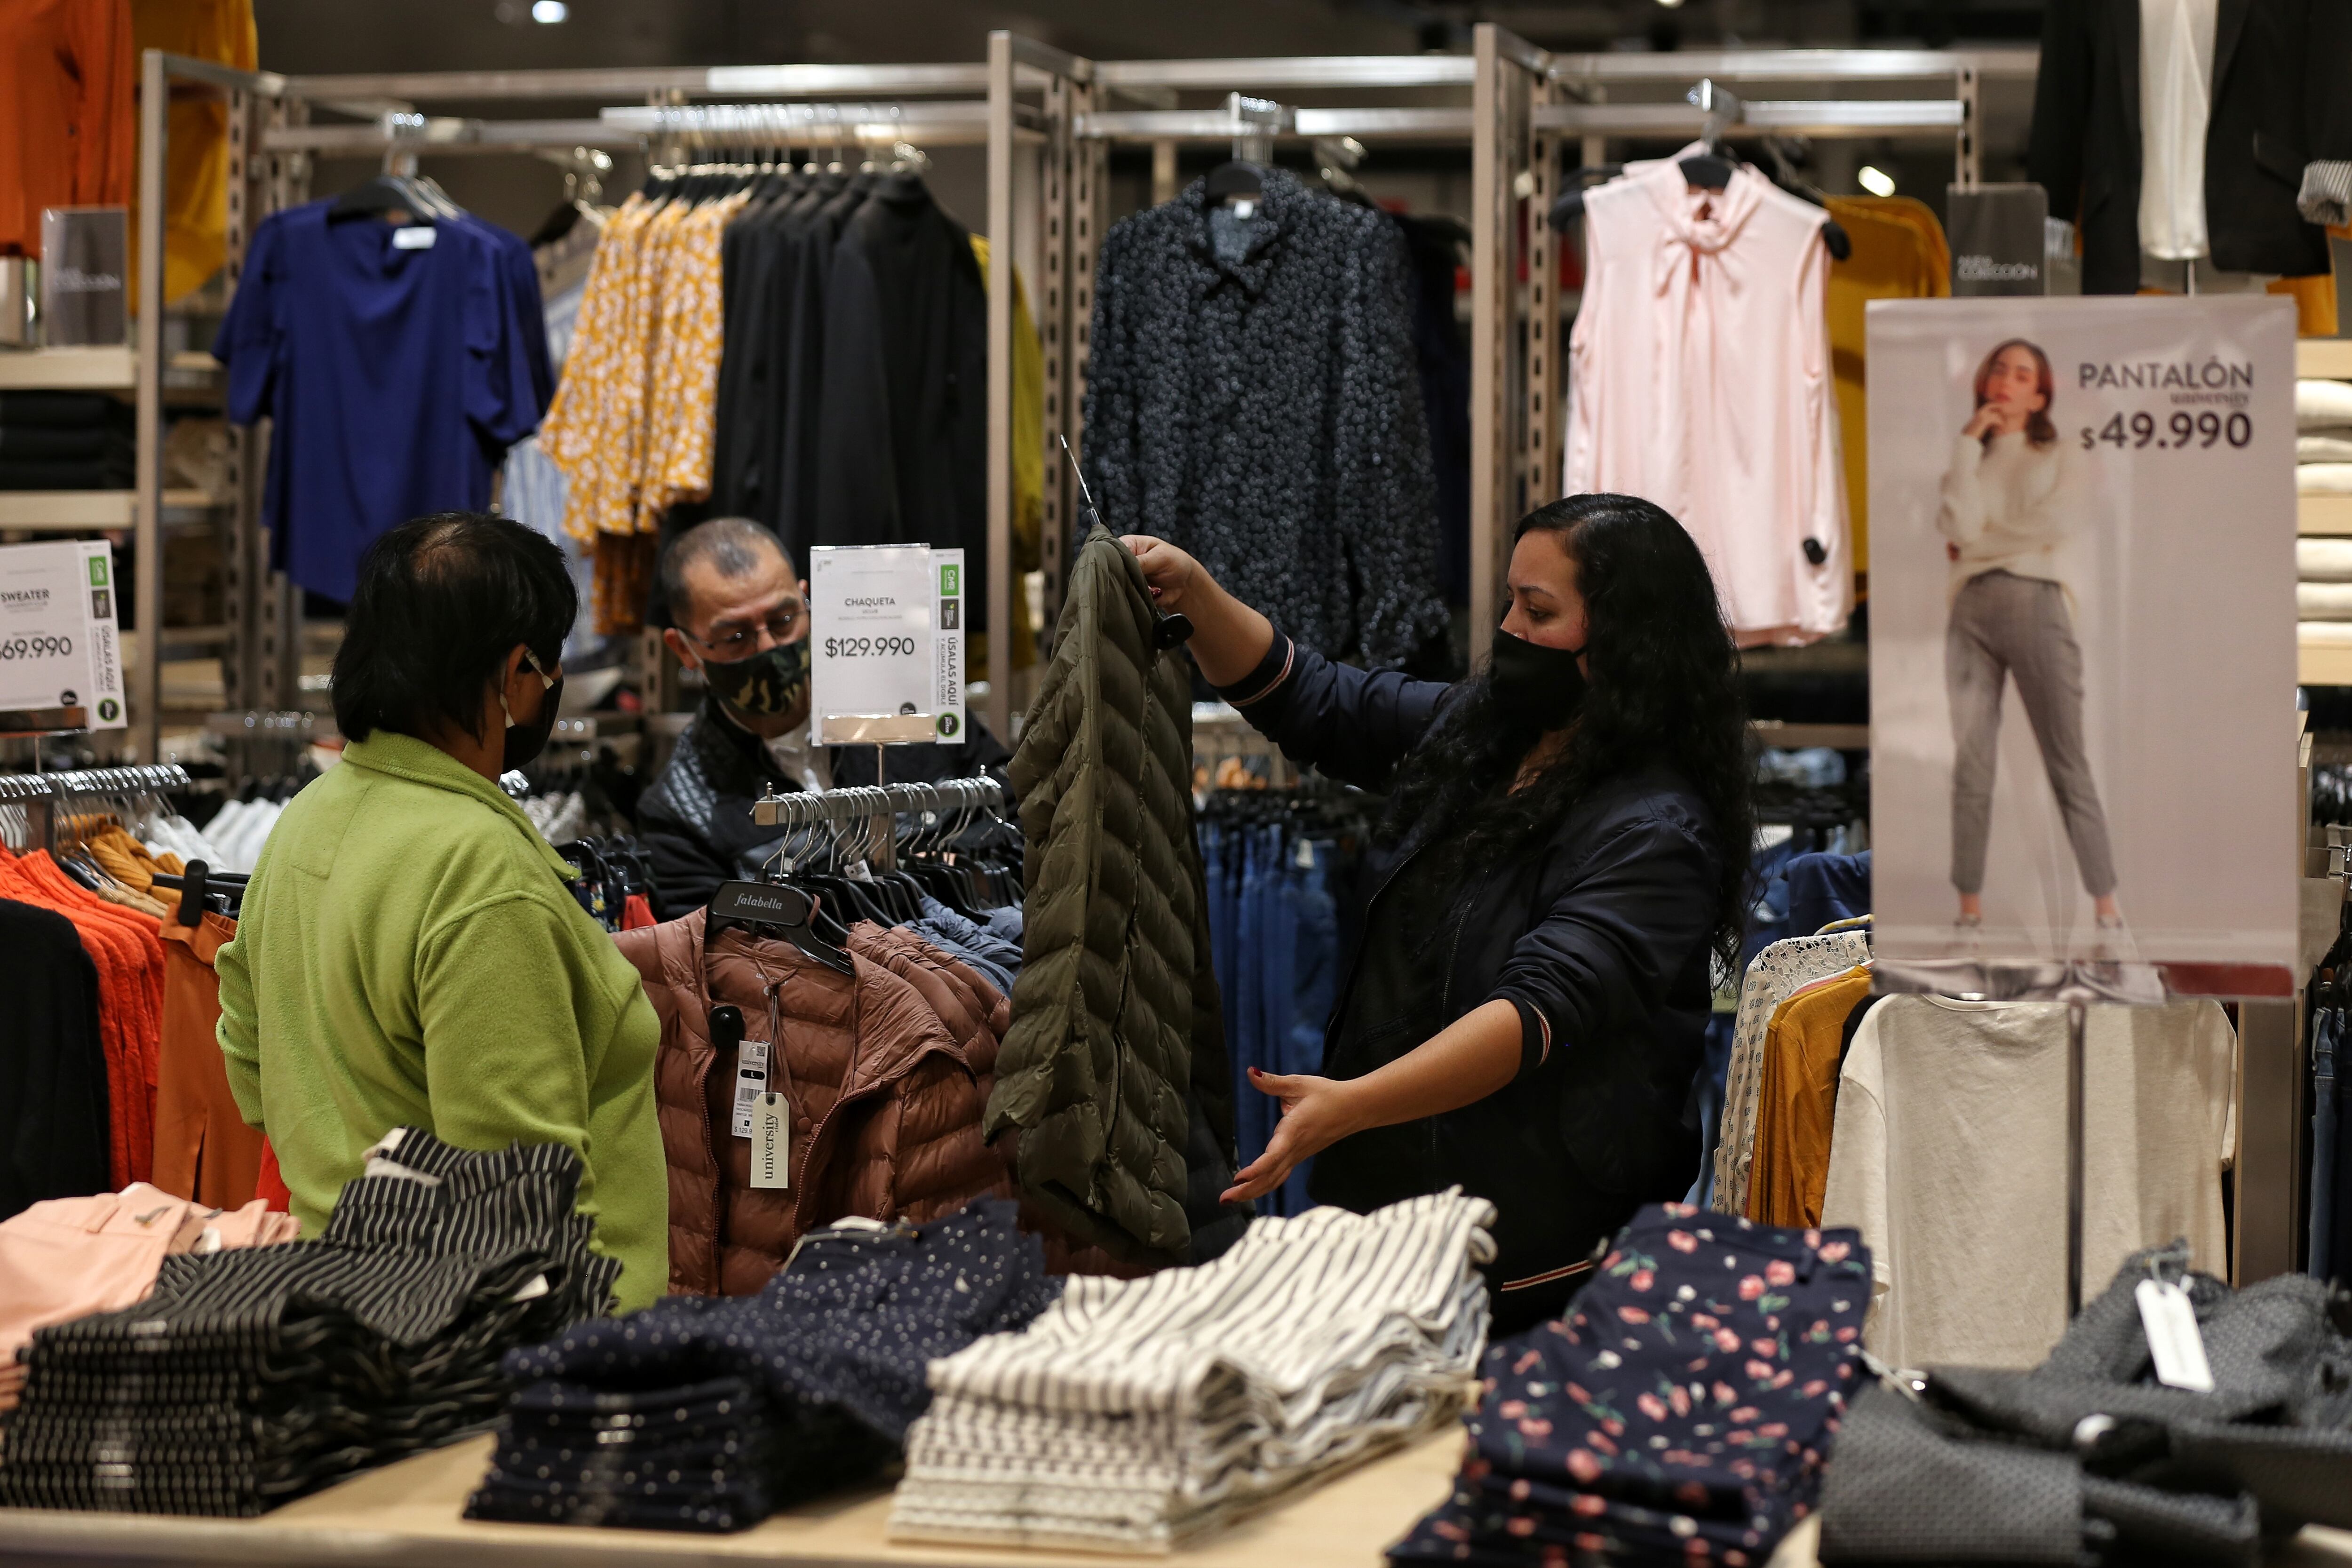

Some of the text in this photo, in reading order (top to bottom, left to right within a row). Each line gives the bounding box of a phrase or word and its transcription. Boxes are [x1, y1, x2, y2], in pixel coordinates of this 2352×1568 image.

[2079, 355, 2254, 389] PANTALÓN
[2080, 411, 2252, 450] $49.990
[0, 589, 49, 602] SWEATER
[844, 597, 896, 607] CHAQUETA
[0, 637, 72, 660] 69.990
[826, 637, 914, 658] $129.990
[948, 637, 958, 677] ÚSALAS
[948, 680, 959, 705] AQUÍ
[734, 893, 782, 909] falabella
[762, 1113, 778, 1180] university
